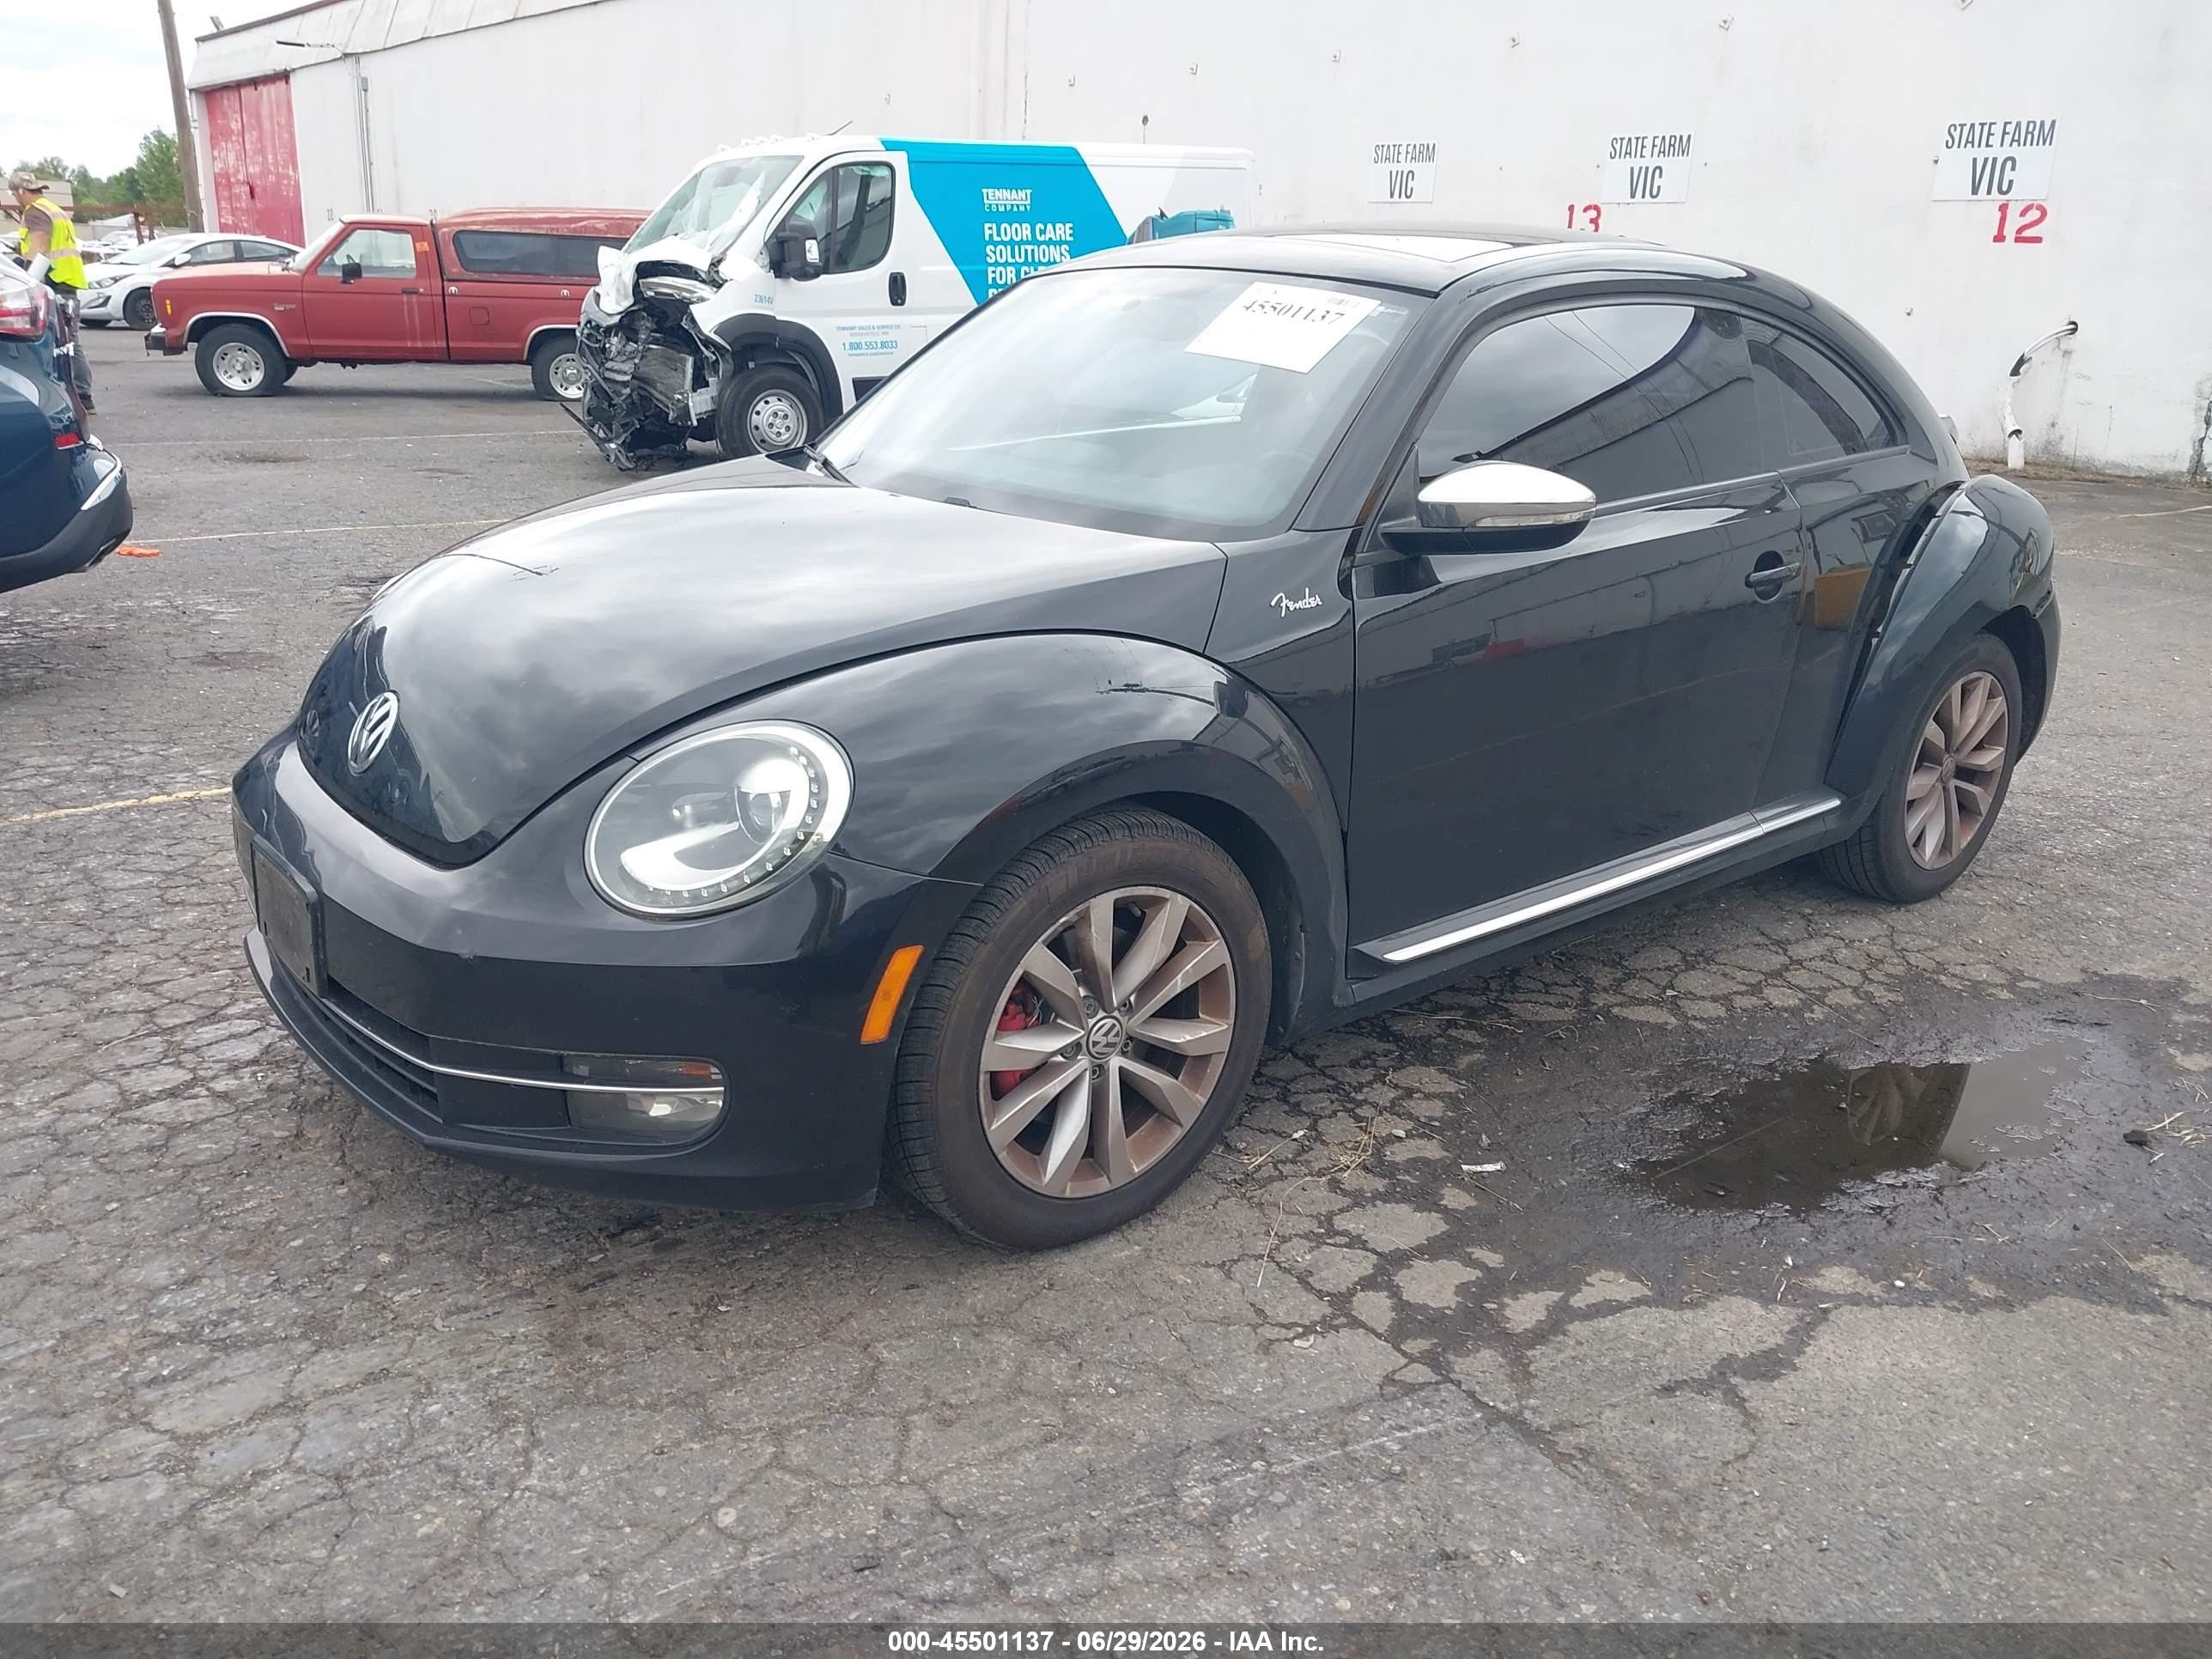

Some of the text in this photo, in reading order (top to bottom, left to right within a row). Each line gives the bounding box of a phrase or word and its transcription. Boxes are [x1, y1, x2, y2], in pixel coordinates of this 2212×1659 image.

[1609, 134, 1692, 160] STATE FARM
[1945, 119, 2057, 149] STATE FARM
[1373, 143, 1437, 164] STATE FARM
[1389, 169, 1415, 199] VIC
[1629, 165, 1663, 199] VIC
[1971, 155, 2017, 196] VIC
[981, 188, 1032, 204] TENNANT
[984, 204, 1031, 212] COMPANY
[983, 222, 1074, 241] FLOOR CARE
[1567, 204, 1601, 233] 13
[1992, 203, 2048, 244] 12
[985, 244, 1071, 264] SOLUTIONS
[987, 265, 1017, 285] FOR
[1270, 586, 1322, 618] Fender
